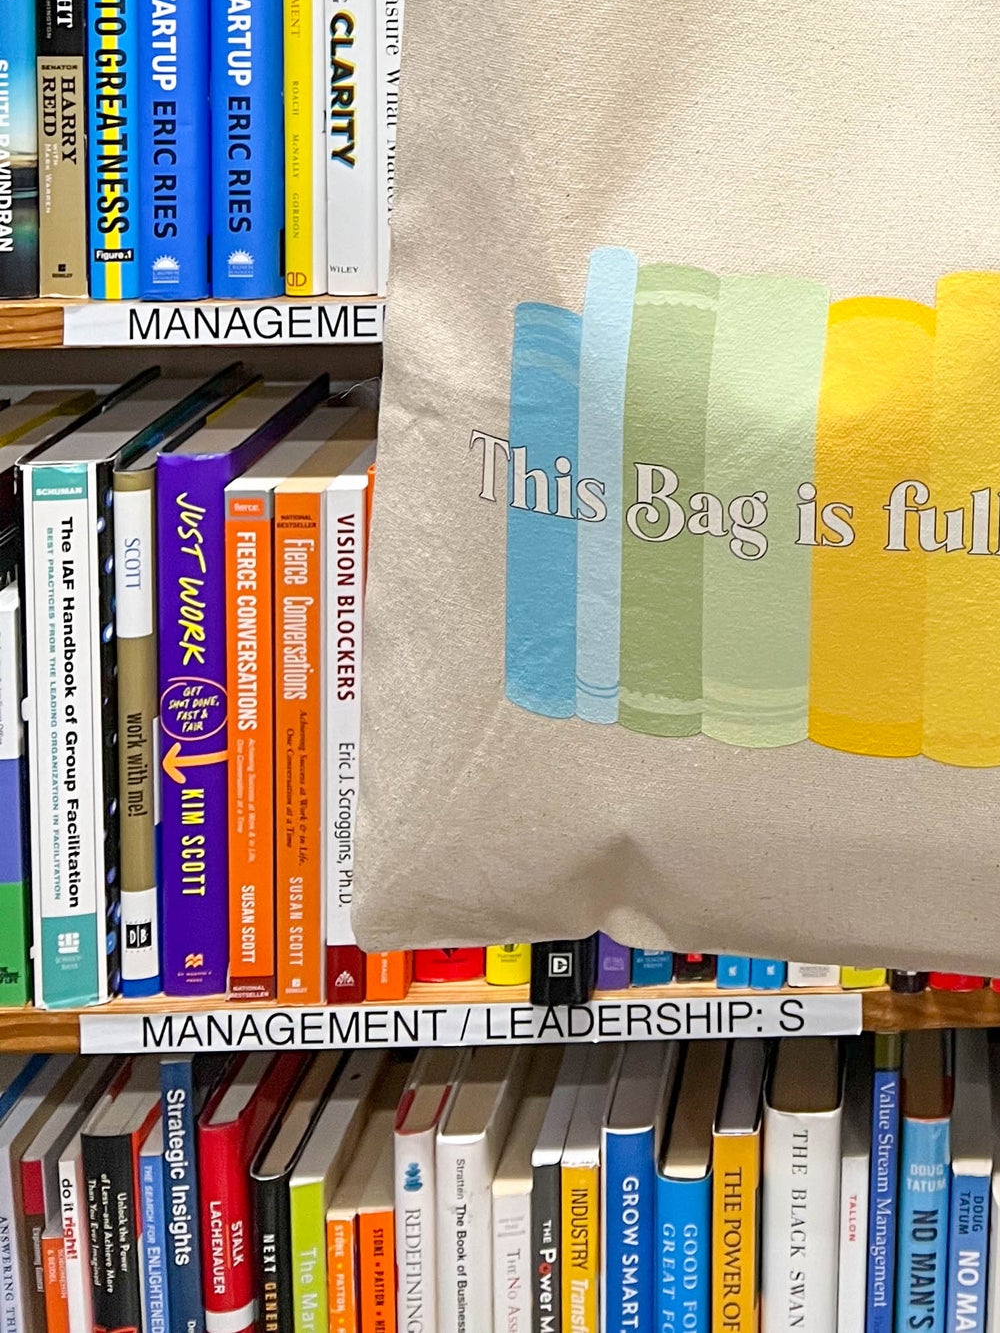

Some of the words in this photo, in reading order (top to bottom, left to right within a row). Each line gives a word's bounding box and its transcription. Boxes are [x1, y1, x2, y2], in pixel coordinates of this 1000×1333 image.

[42, 77, 57, 137] REID
[61, 77, 77, 166] HARRY
[330, 9, 358, 169] CLARITY
[96, 49, 129, 234] GREATNESS
[153, 101, 177, 166] ERIC
[228, 96, 251, 161] ERIC
[153, 174, 177, 239] RIES
[228, 169, 251, 234] RIES
[330, 265, 358, 274] WILEY
[129, 304, 387, 342] MANAGEME
[35, 487, 83, 496] SCHUMAN
[469, 428, 608, 523] This
[625, 461, 769, 561] Bag
[793, 481, 856, 548] is
[61, 517, 74, 553] The
[176, 492, 207, 574] JUST
[236, 532, 257, 591] FIERCE
[283, 538, 315, 586] Fierce
[337, 513, 355, 586] VISION
[62, 559, 75, 591] IAF
[63, 597, 77, 699] Handbook
[178, 577, 207, 666] WORK
[283, 596, 315, 701] Conversations
[337, 595, 355, 701] BLOCKERS
[236, 595, 258, 731] CONVERSATIONS
[64, 703, 78, 725] of
[64, 730, 79, 792] Group
[181, 788, 204, 825] KIM
[66, 798, 82, 908] Facilitation
[181, 835, 205, 897] SCOTT
[241, 885, 255, 925] SUSAN
[289, 876, 303, 920] SUSAN
[241, 927, 256, 964] SCOTT
[289, 926, 303, 966] SCOTT
[142, 1009, 447, 1049] MANAGEMENT
[462, 1009, 470, 1042] /
[485, 1000, 764, 1041] LEADERSHIP:
[778, 999, 806, 1033] S
[165, 1088, 186, 1180] Strategic
[879, 1082, 895, 1130] Value
[792, 1129, 809, 1175] THE
[877, 1133, 894, 1194] Stream
[168, 1185, 190, 1267] Insights
[231, 1221, 244, 1267] STALK
[571, 1188, 588, 1271] INDUSTRY
[621, 1176, 639, 1247] GROW
[790, 1189, 807, 1258] BLACK
[209, 1201, 226, 1295] LACHENAUER
[871, 1198, 892, 1308] Management
[788, 1271, 805, 1328] SWAN
